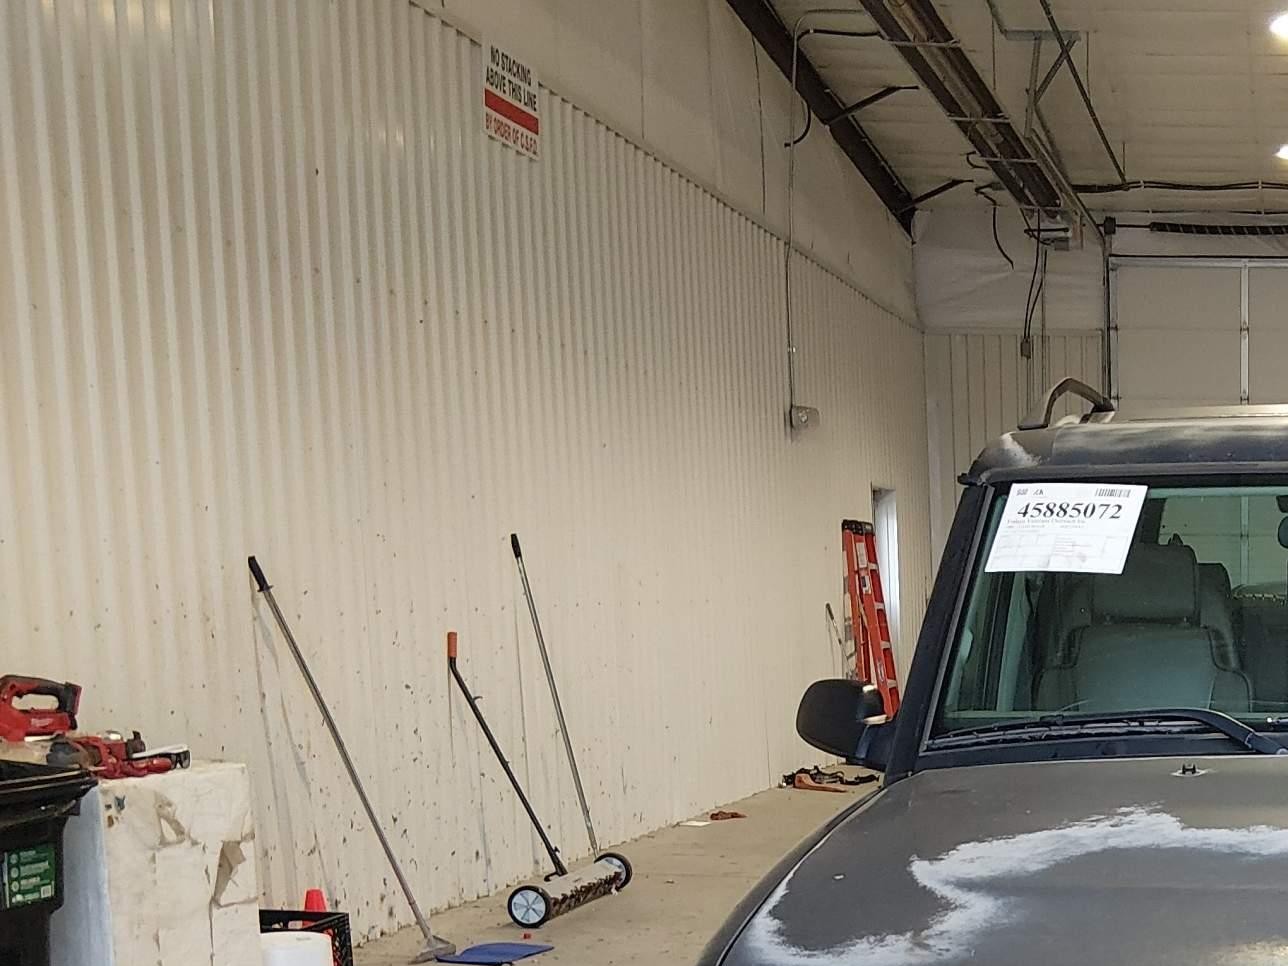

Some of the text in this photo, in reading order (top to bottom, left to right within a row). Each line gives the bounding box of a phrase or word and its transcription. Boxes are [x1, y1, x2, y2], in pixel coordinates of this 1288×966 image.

[490, 45, 532, 87] NO STACKING
[486, 66, 537, 112] ABOVE THIS LINE
[485, 112, 492, 130] BY
[493, 118, 511, 143] ORDER
[512, 127, 519, 146] OF
[1017, 501, 1123, 519] 45885072
